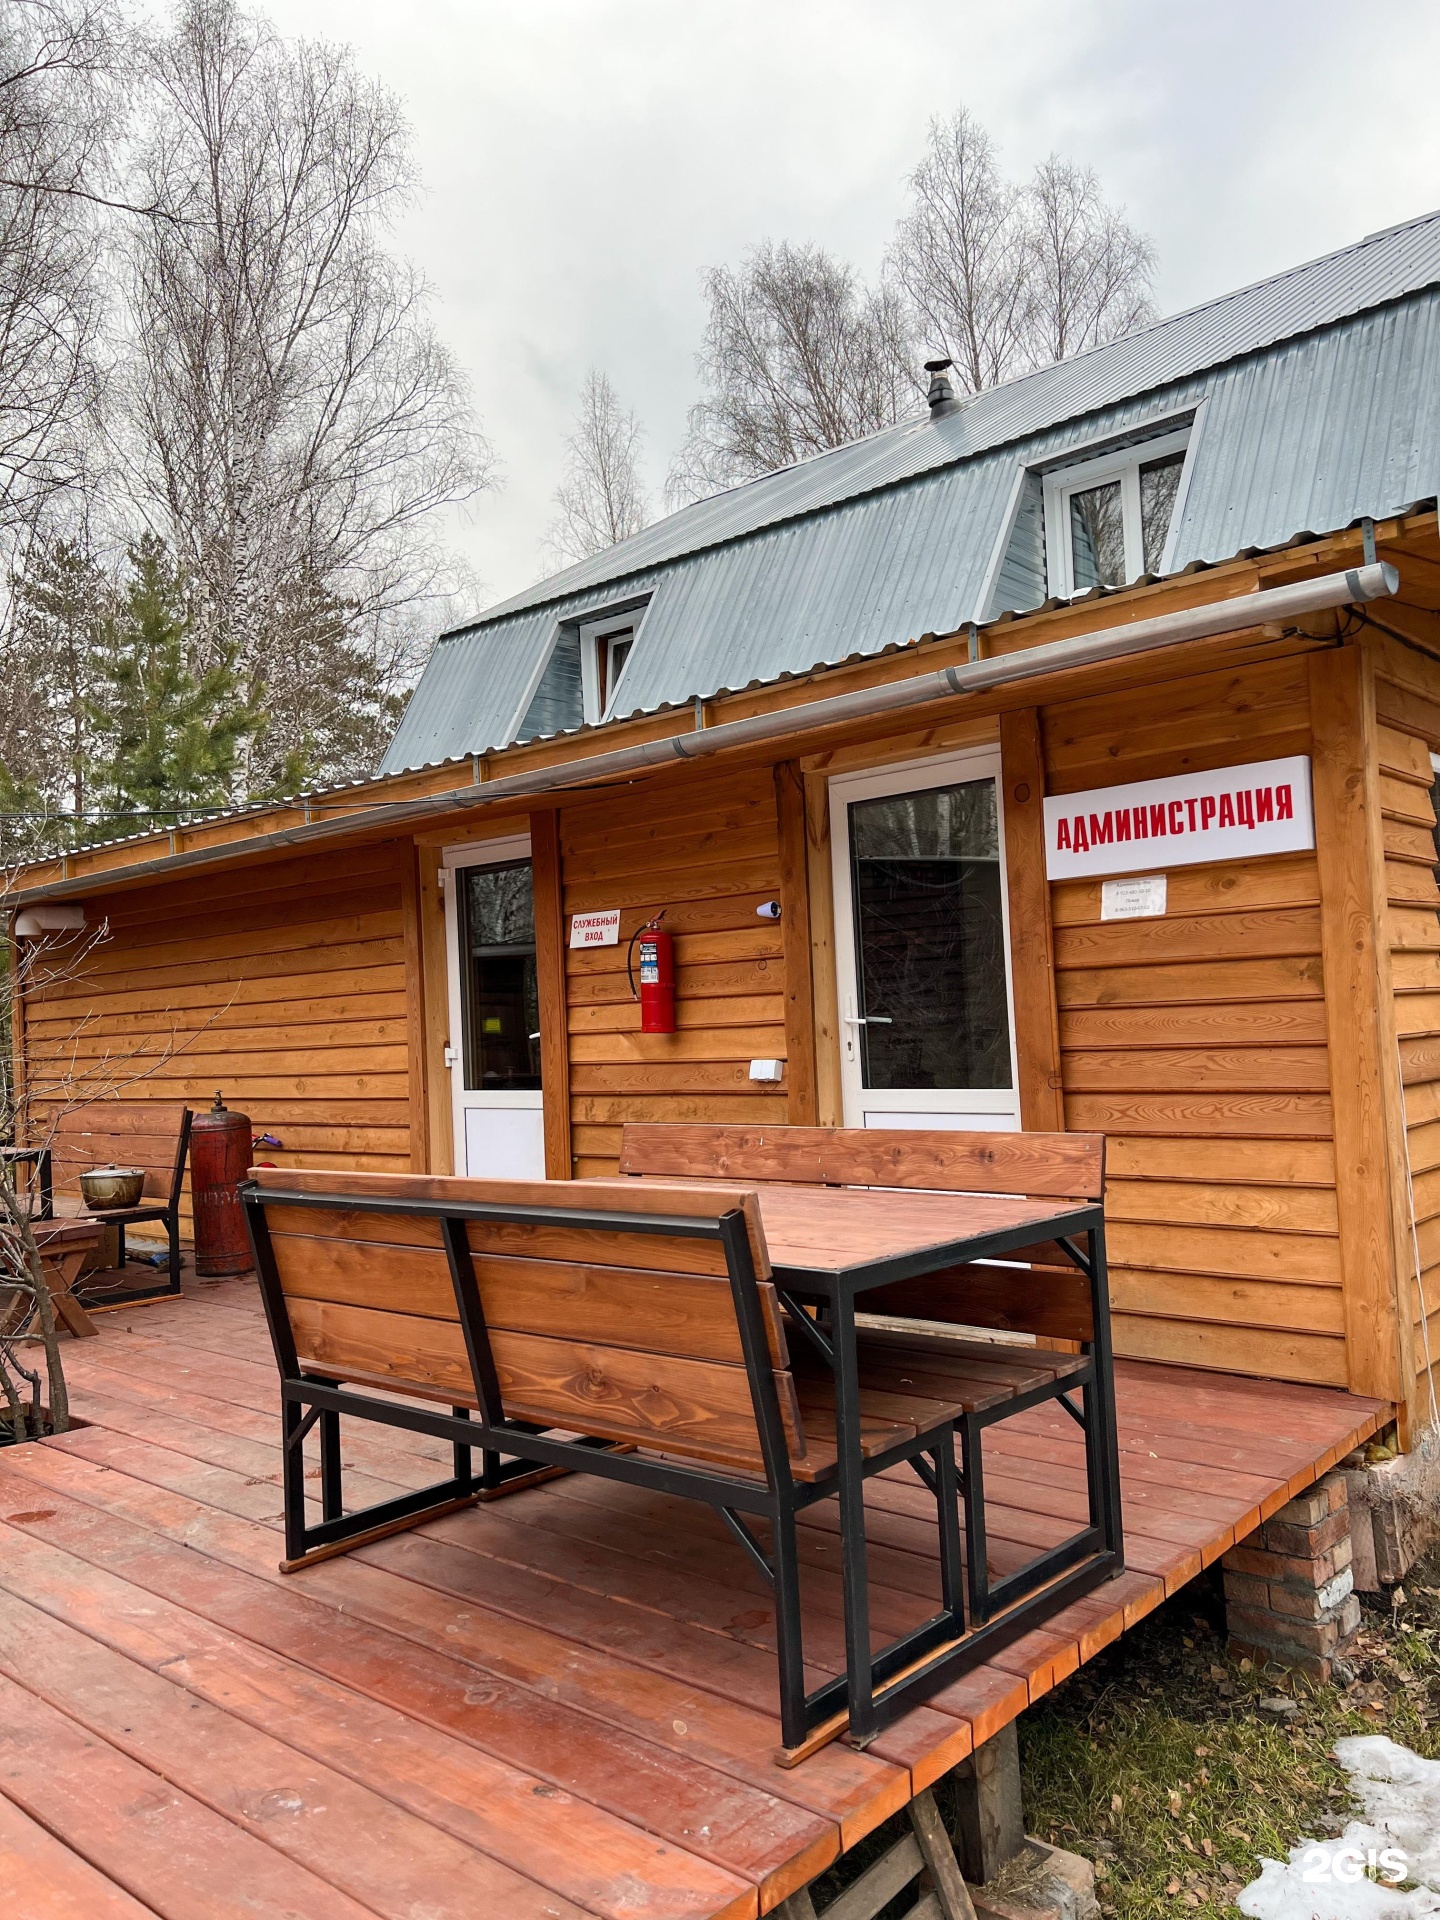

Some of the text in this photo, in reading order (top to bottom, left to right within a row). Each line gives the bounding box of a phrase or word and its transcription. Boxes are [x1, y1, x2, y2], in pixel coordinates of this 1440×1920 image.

[1057, 784, 1293, 853] АДМИНИСТРАЦИЯ
[573, 914, 618, 929] СЛУЖЕБНЫЙ
[585, 931, 604, 942] ВХОД
